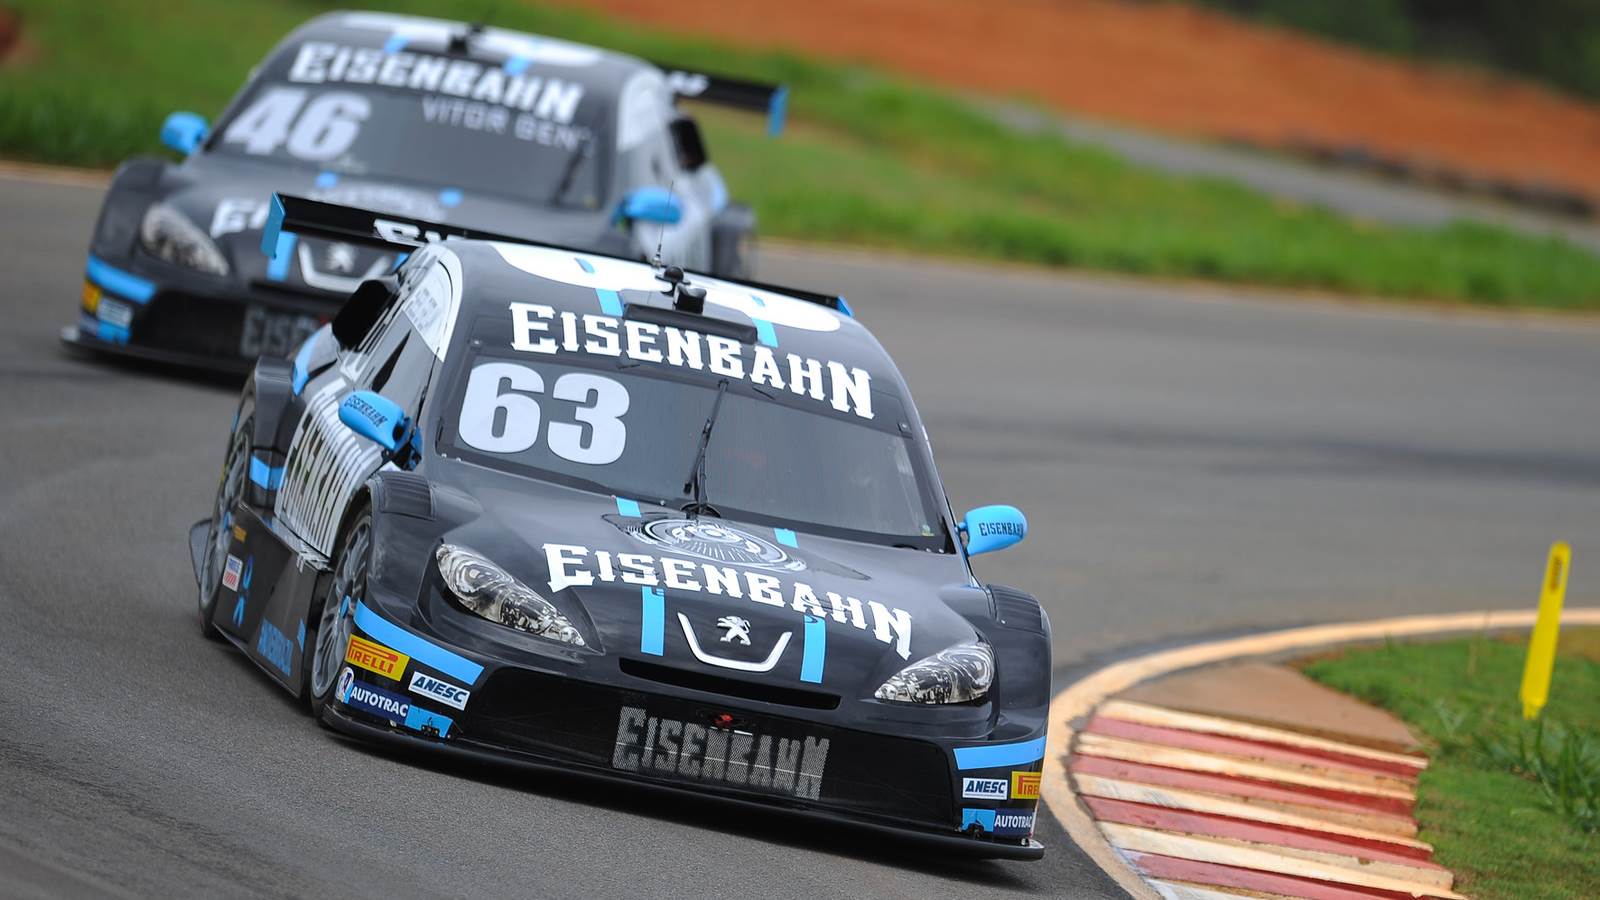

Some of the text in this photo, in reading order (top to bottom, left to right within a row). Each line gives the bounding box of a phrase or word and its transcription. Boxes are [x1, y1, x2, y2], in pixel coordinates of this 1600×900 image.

[289, 41, 583, 123] EISENBAHN
[421, 95, 509, 134] VITOR
[222, 86, 371, 162] 46
[508, 301, 875, 420] EISENBAHN
[457, 362, 630, 465] 63
[542, 543, 912, 661] EISENBAHN
[348, 639, 398, 675] PIRELLI
[412, 676, 467, 704] ANESC
[349, 686, 409, 718] AUTOTRAC
[611, 705, 830, 801] EISENBAHN
[965, 779, 1006, 794] ANESC
